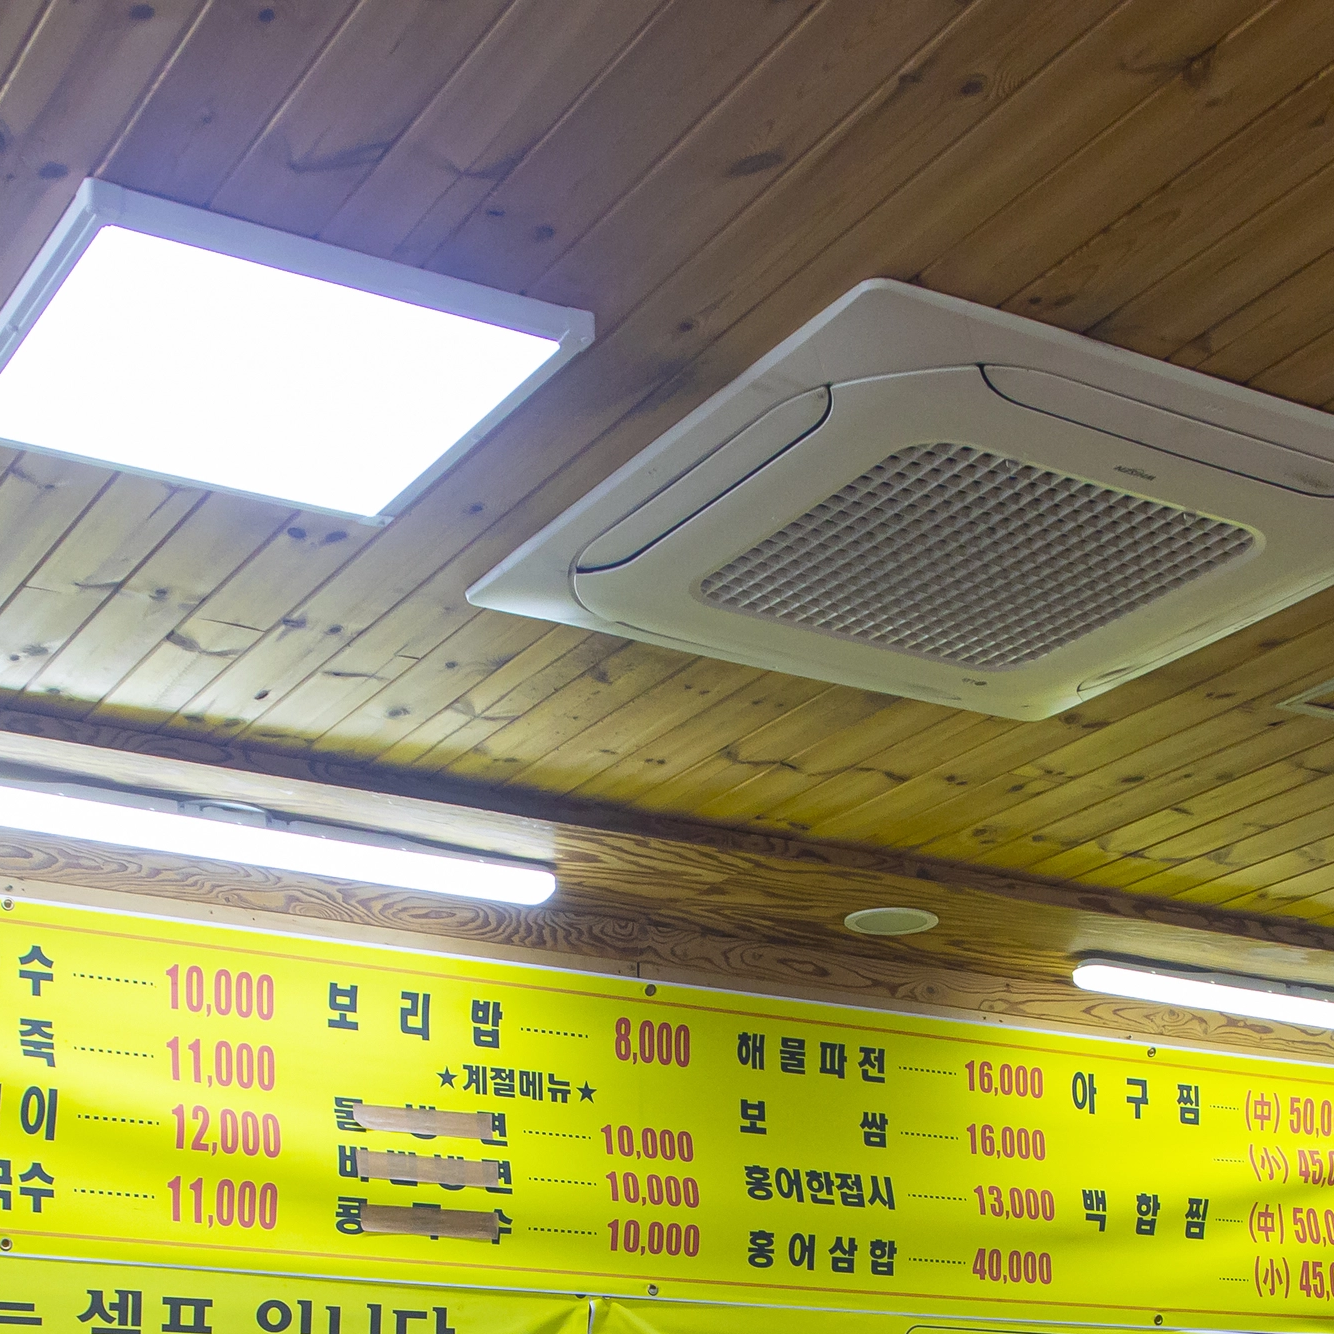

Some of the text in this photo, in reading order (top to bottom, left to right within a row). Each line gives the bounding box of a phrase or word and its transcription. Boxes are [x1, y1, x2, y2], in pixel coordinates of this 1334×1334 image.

[166, 964, 274, 1020] 10,000
[328, 983, 690, 1067] 보리밥 8,000
[167, 1037, 275, 1091] 11,000
[463, 1065, 571, 1103] 계절메뉴
[737, 1029, 1043, 1098] 해물파전 16,000
[1072, 1072, 1199, 1125] 아구찜
[1246, 1090, 1280, 1133] (中)
[172, 1104, 281, 1158] 12,000
[601, 1124, 693, 1162] 10,000
[967, 1124, 1045, 1160] 16,000
[606, 1171, 699, 1208] 10,000
[1249, 1144, 1289, 1184] (小)
[168, 1176, 277, 1229] 11,000
[745, 1165, 1055, 1221] 홍어한접시 13,000
[1082, 1190, 1209, 1239] 백합찜
[1249, 1202, 1284, 1244] (中)
[608, 1219, 699, 1257] 10,000
[748, 1230, 1052, 1284] 홍어삼합 40,000
[1255, 1256, 1290, 1298] (小)
